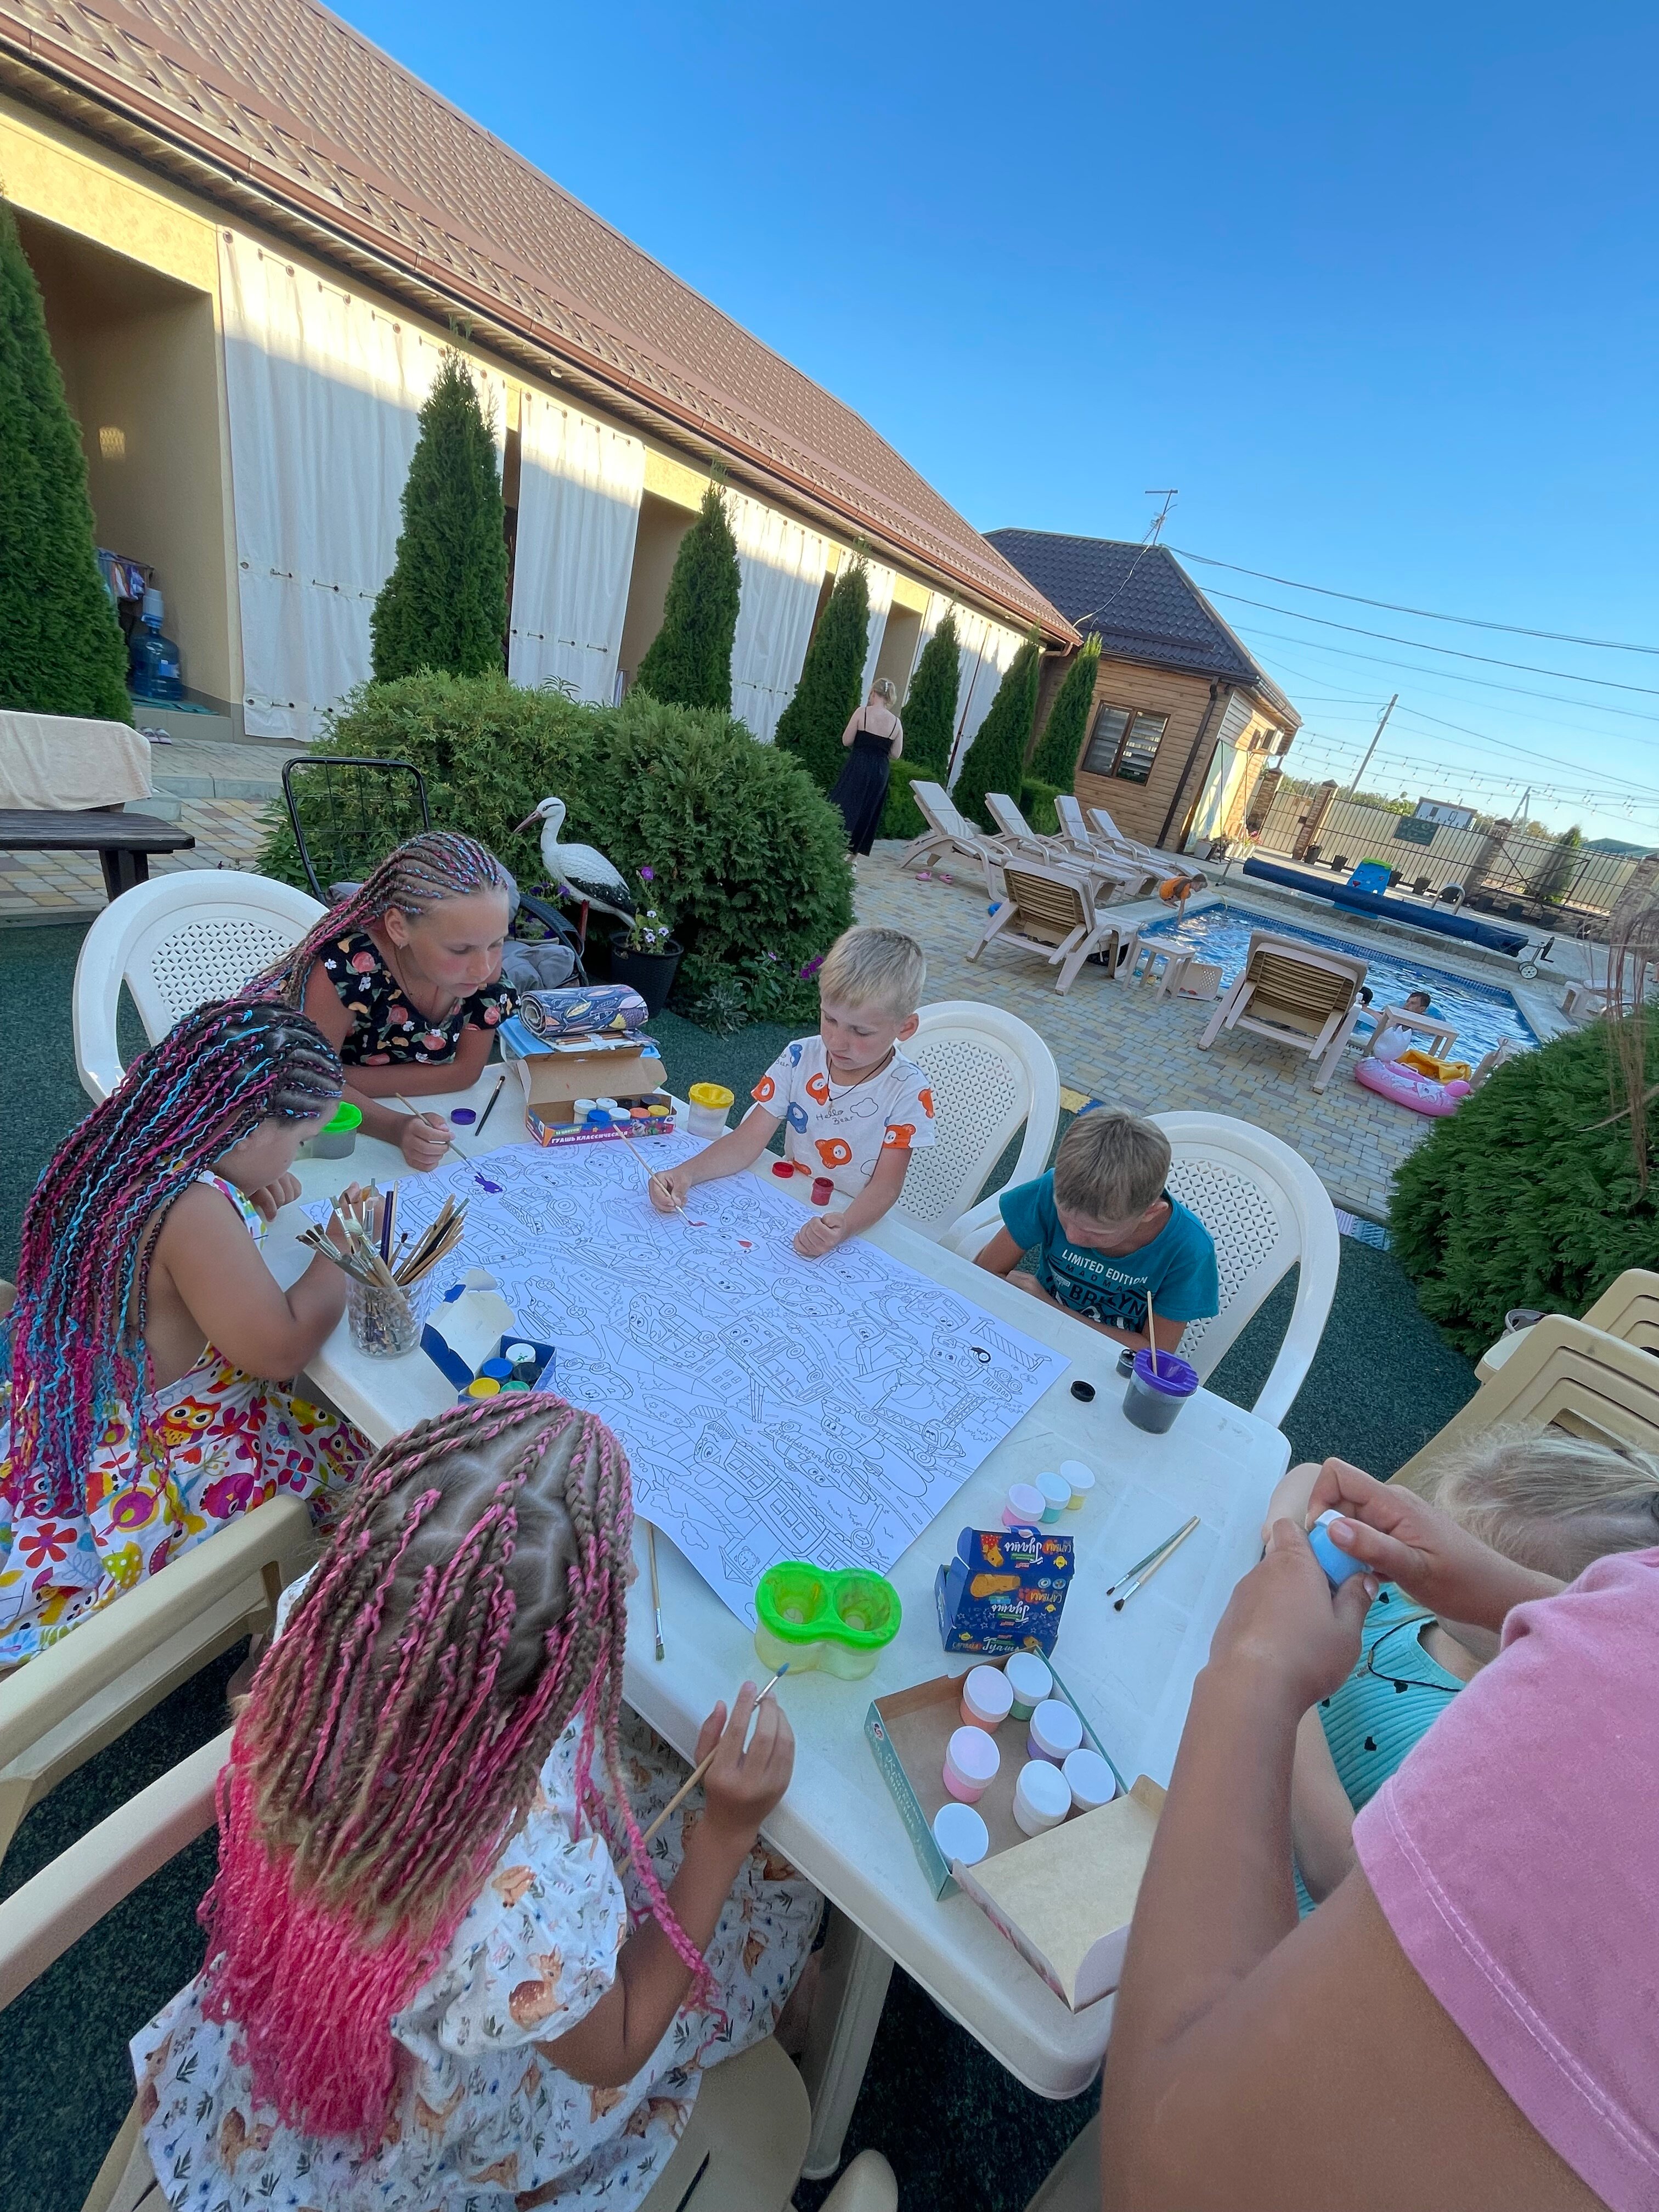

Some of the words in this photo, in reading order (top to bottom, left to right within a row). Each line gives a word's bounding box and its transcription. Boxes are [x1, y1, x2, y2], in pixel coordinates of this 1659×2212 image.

[816, 1109, 844, 1121] Hello
[832, 1116, 854, 1125] Bear
[576, 1131, 628, 1141] КЛАССИЧЕСКЯ
[1062, 1249, 1104, 1274] LIMITED
[1105, 1268, 1148, 1286] EDITION
[1004, 1537, 1043, 1565] Гуашь
[1046, 1542, 1071, 1554] CAPYBARA
[1031, 1592, 1063, 1604] CAPYBARA
[992, 1601, 1030, 1623] Гуашь
